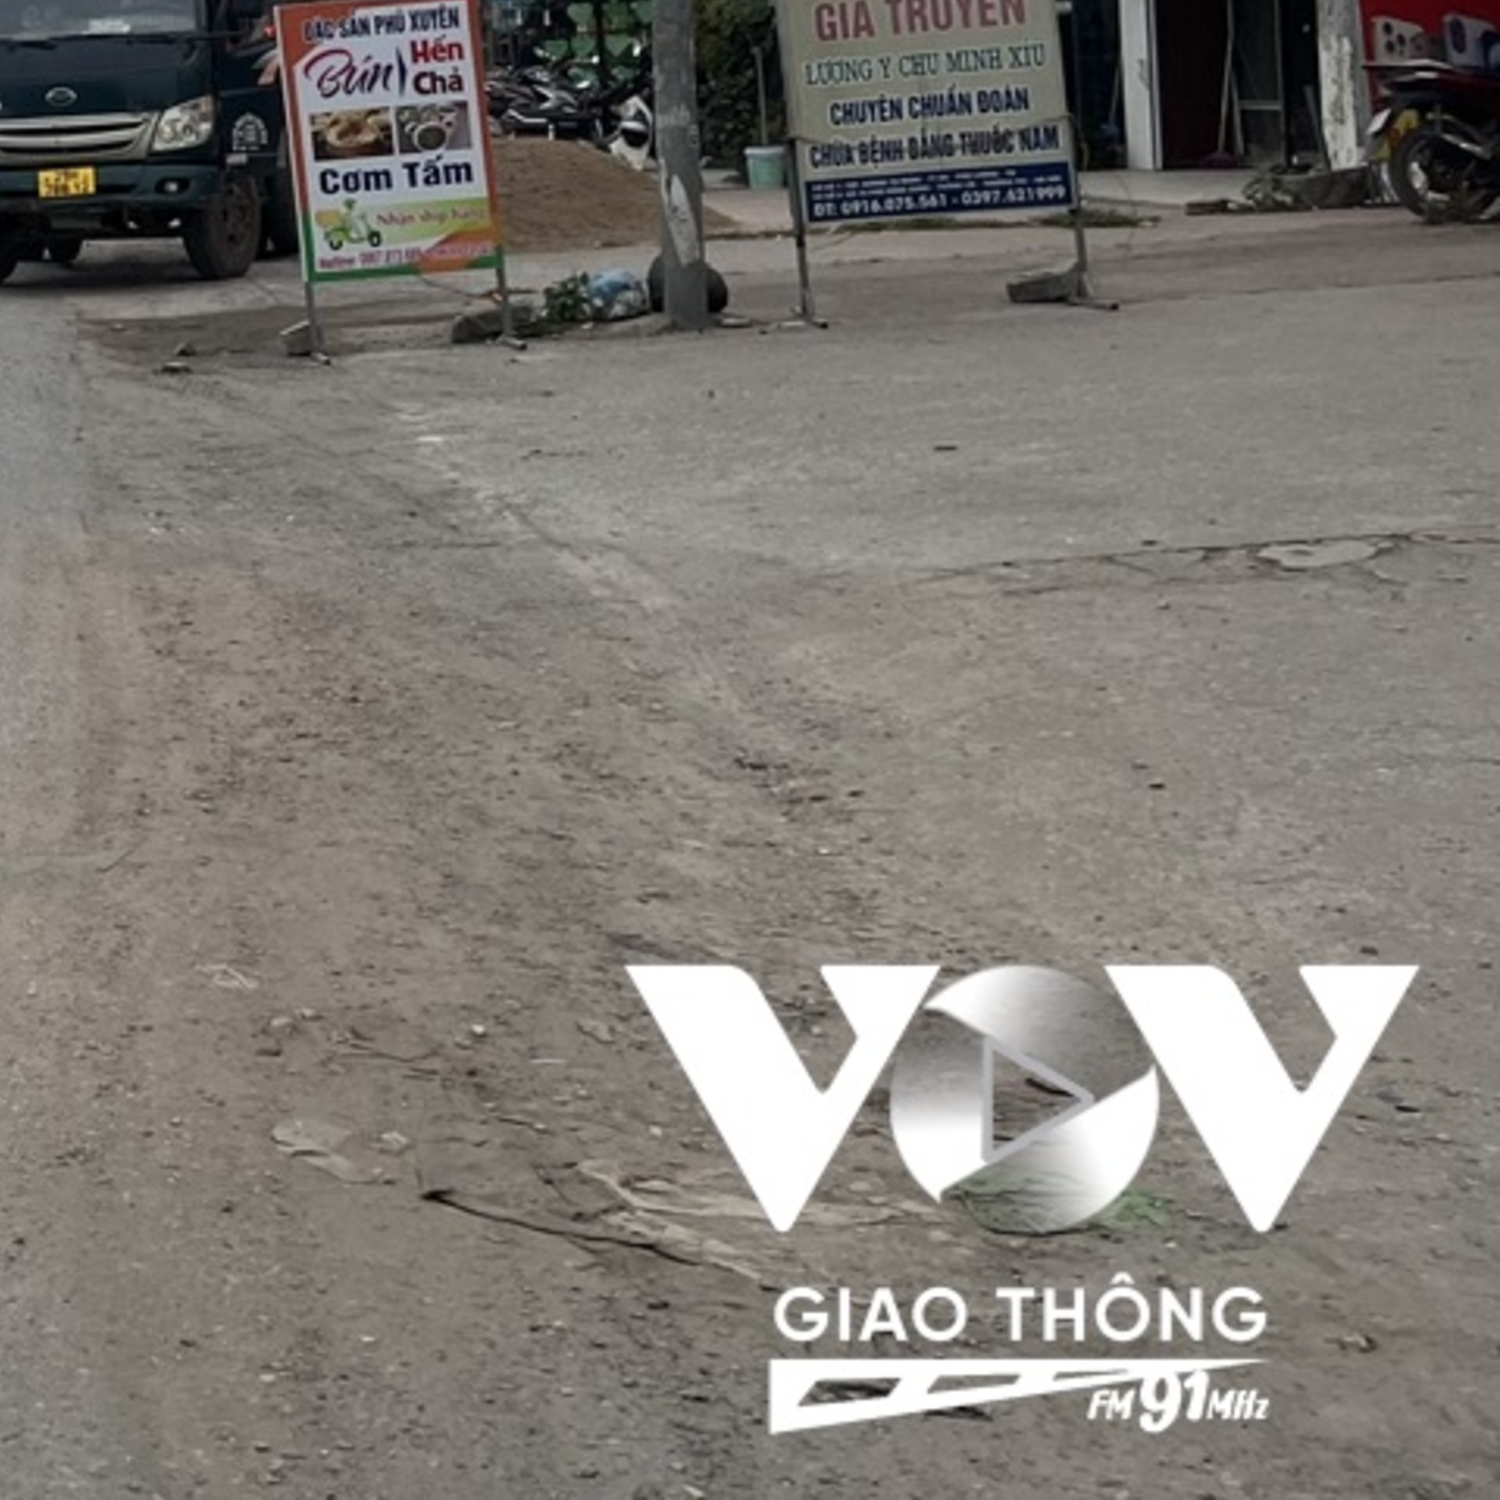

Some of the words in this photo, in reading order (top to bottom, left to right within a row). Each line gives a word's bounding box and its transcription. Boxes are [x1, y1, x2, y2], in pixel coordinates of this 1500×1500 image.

[409, 4, 460, 33] XUYÊN
[411, 35, 464, 64] Hến
[877, 58, 892, 79] Y
[899, 52, 941, 77] CHU
[946, 48, 1003, 73] MINH
[413, 64, 464, 95] Chả
[829, 92, 903, 125] CHUYÊN
[1019, 125, 1060, 151] NAM
[320, 167, 393, 195] Cơm
[402, 154, 473, 188] Tấm
